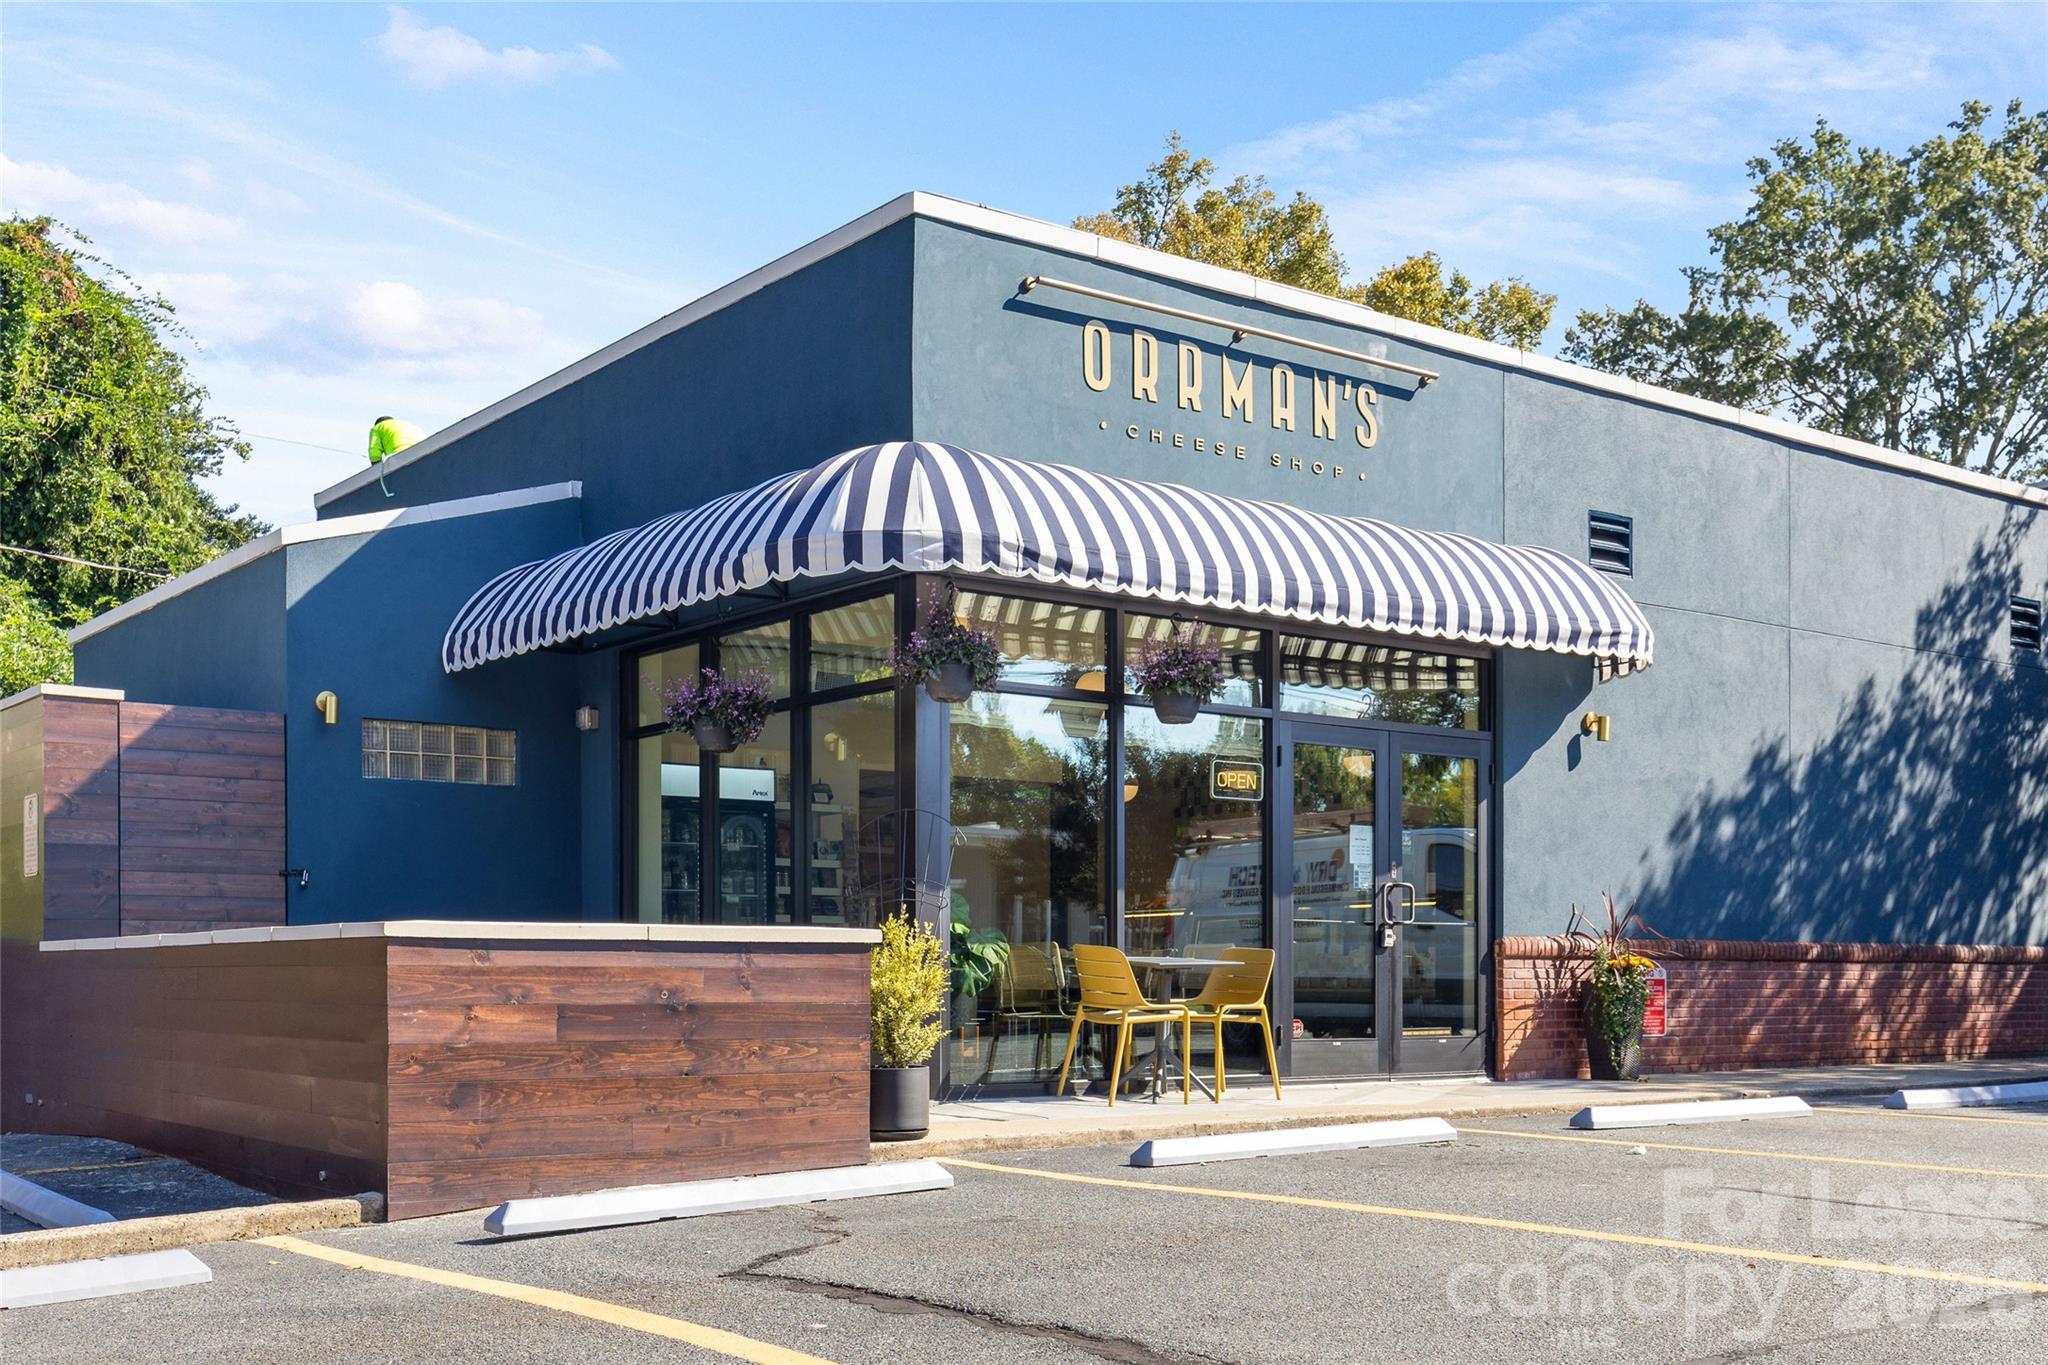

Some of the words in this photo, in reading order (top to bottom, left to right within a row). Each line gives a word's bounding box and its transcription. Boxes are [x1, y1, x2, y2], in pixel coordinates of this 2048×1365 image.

[1083, 319, 1378, 448] ORRMAN'S
[1126, 424, 1246, 459] CHEESE
[1271, 453, 1344, 478] SHOP
[1217, 771, 1257, 790] OPEN
